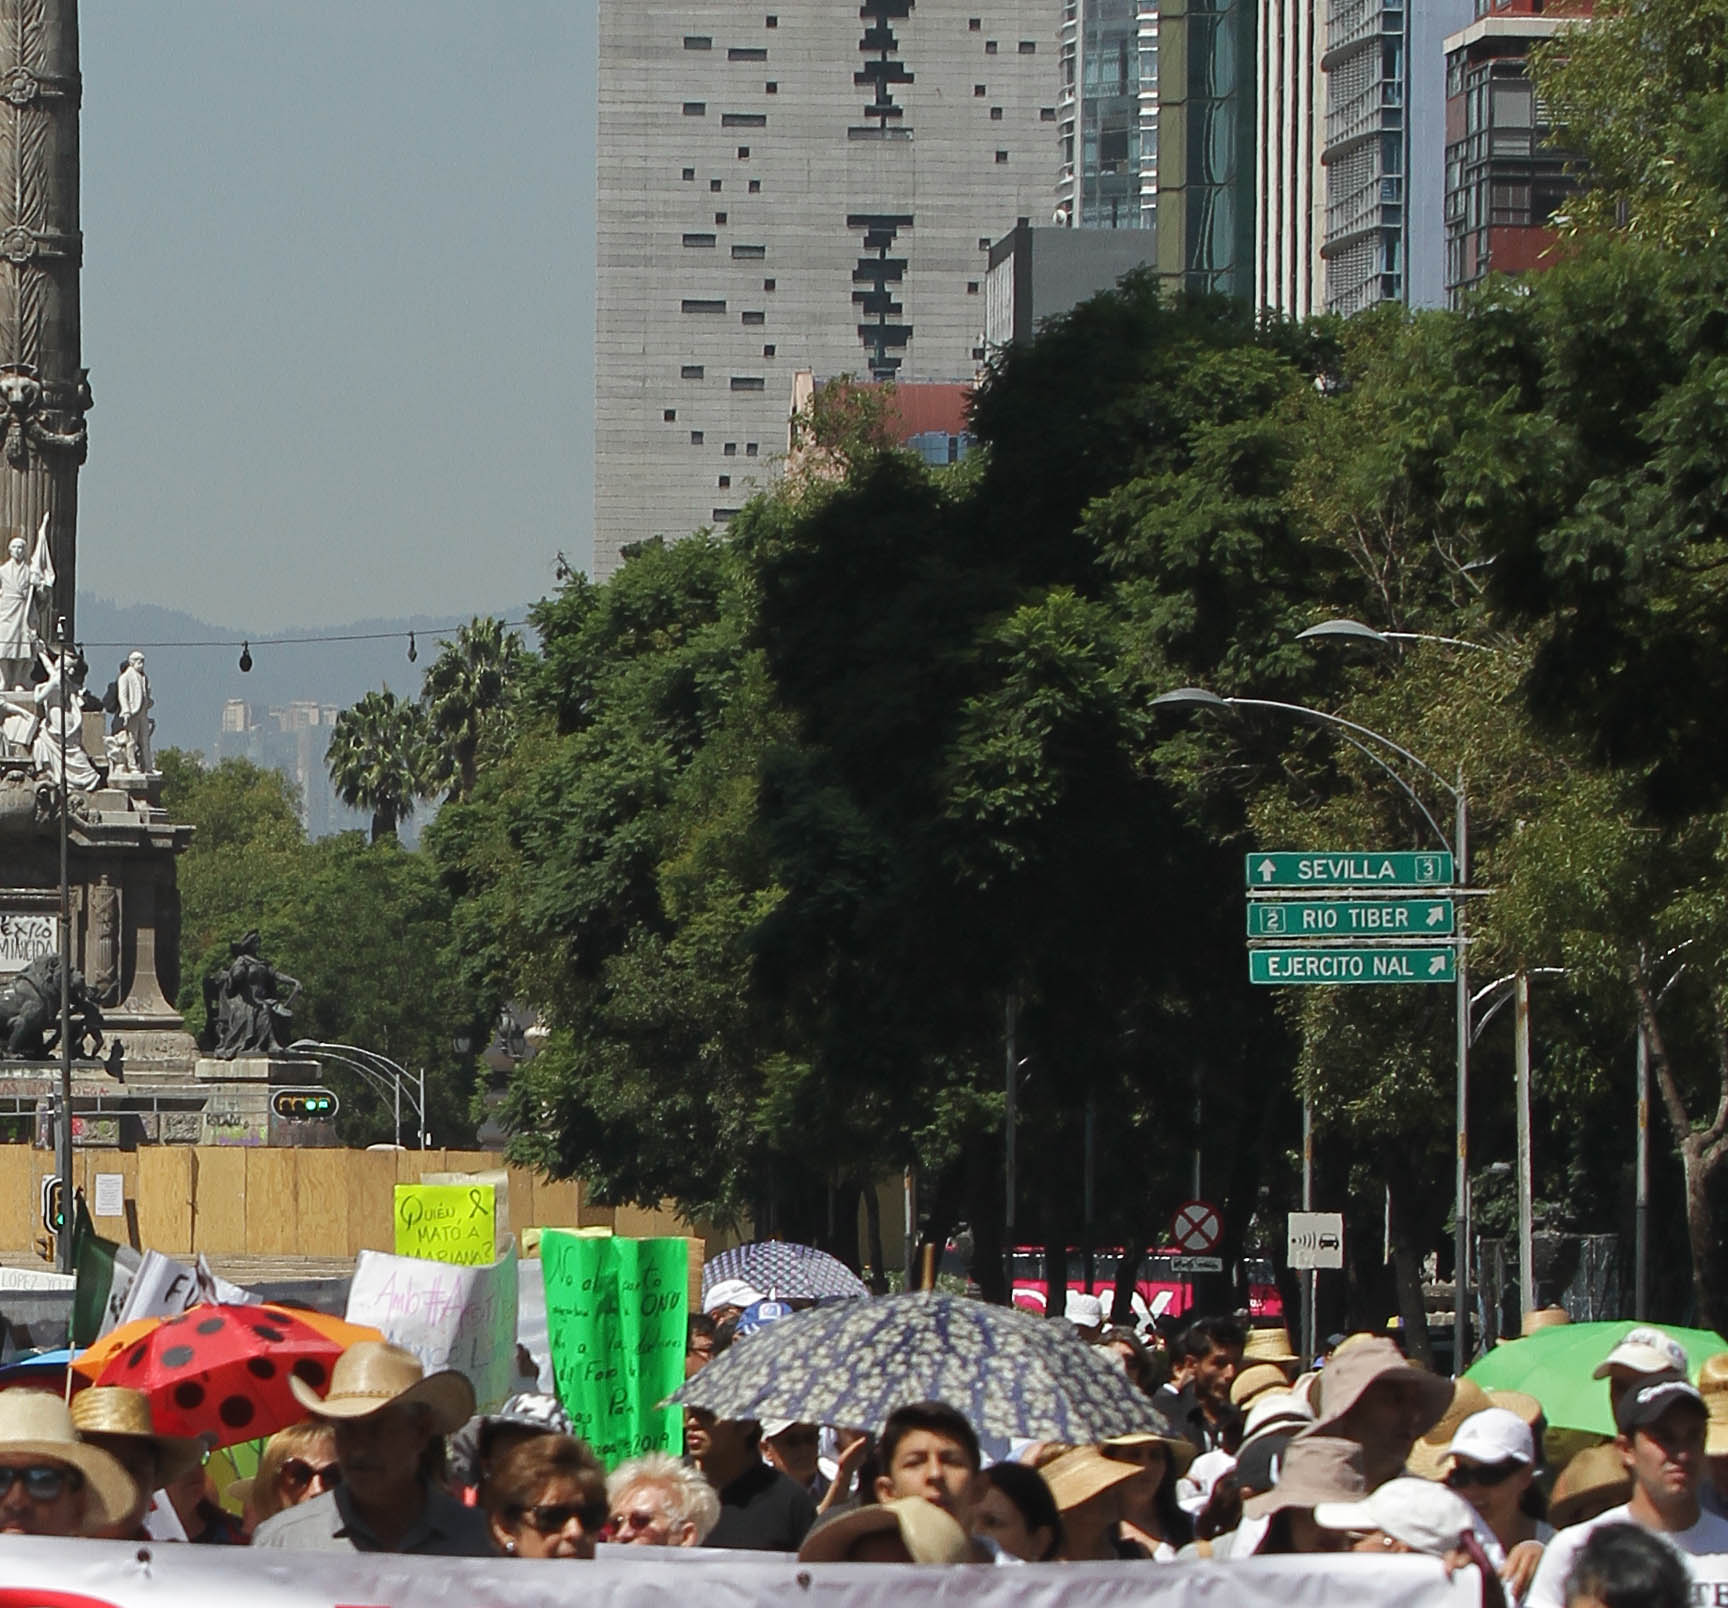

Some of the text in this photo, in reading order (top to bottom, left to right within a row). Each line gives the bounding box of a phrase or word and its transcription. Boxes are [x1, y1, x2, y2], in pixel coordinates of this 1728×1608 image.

[1297, 859, 1396, 880] SEVILLA
[1302, 908, 1338, 929] RIO
[1348, 907, 1409, 928] TIBER
[1267, 955, 1415, 977] EJERCITO NAL
[417, 1217, 481, 1243] MATÓ A
